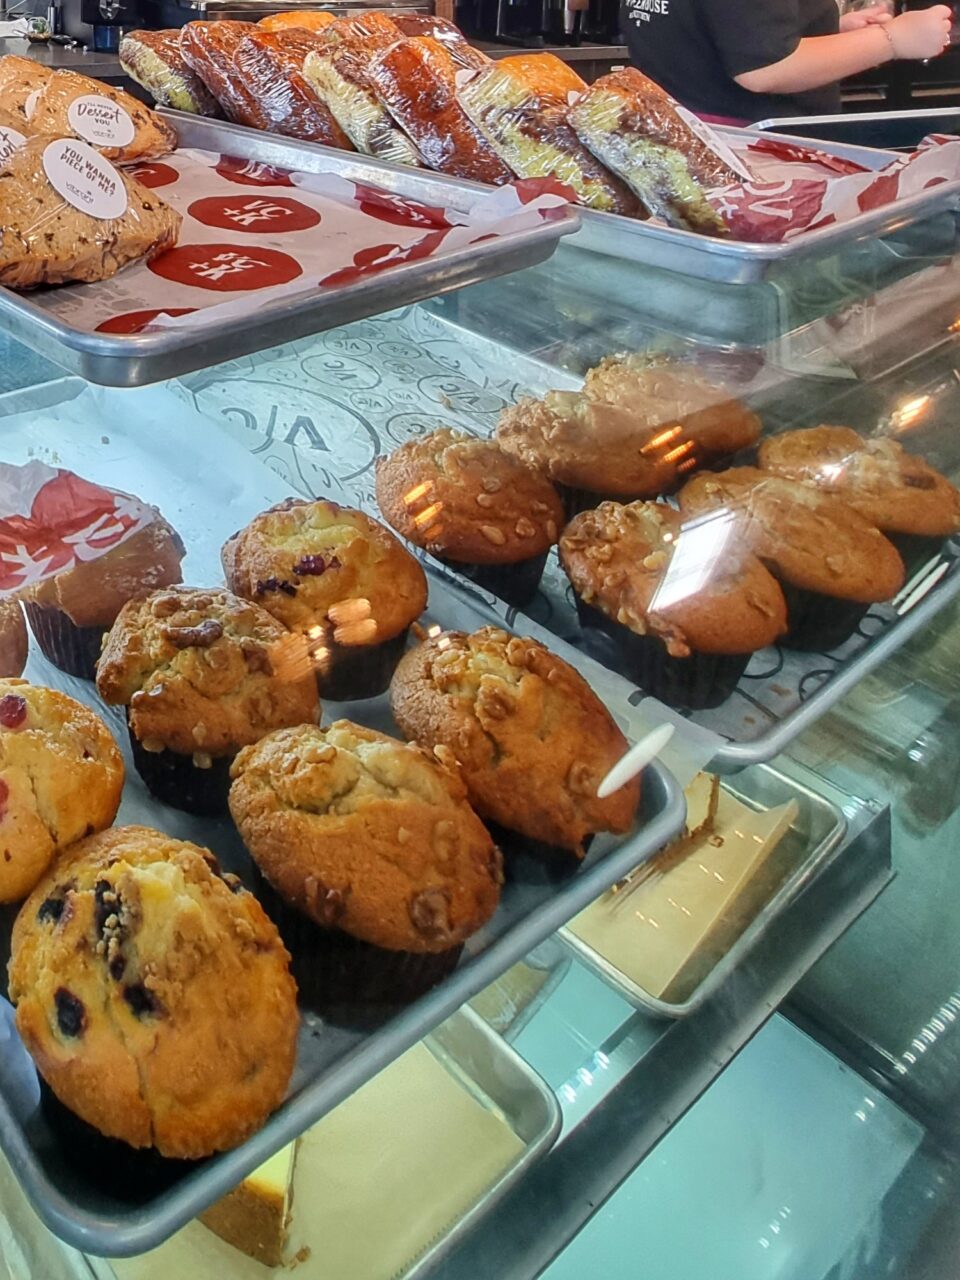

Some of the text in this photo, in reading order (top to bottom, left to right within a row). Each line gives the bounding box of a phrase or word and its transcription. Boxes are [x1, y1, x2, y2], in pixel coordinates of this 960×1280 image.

[77, 103, 122, 123] Dessert
[94, 118, 110, 126] YOU
[60, 153, 115, 197] PIECE OF ME?
[64, 146, 116, 191] YOU WANNA
[222, 207, 263, 227] +K
[242, 199, 294, 219] VC
